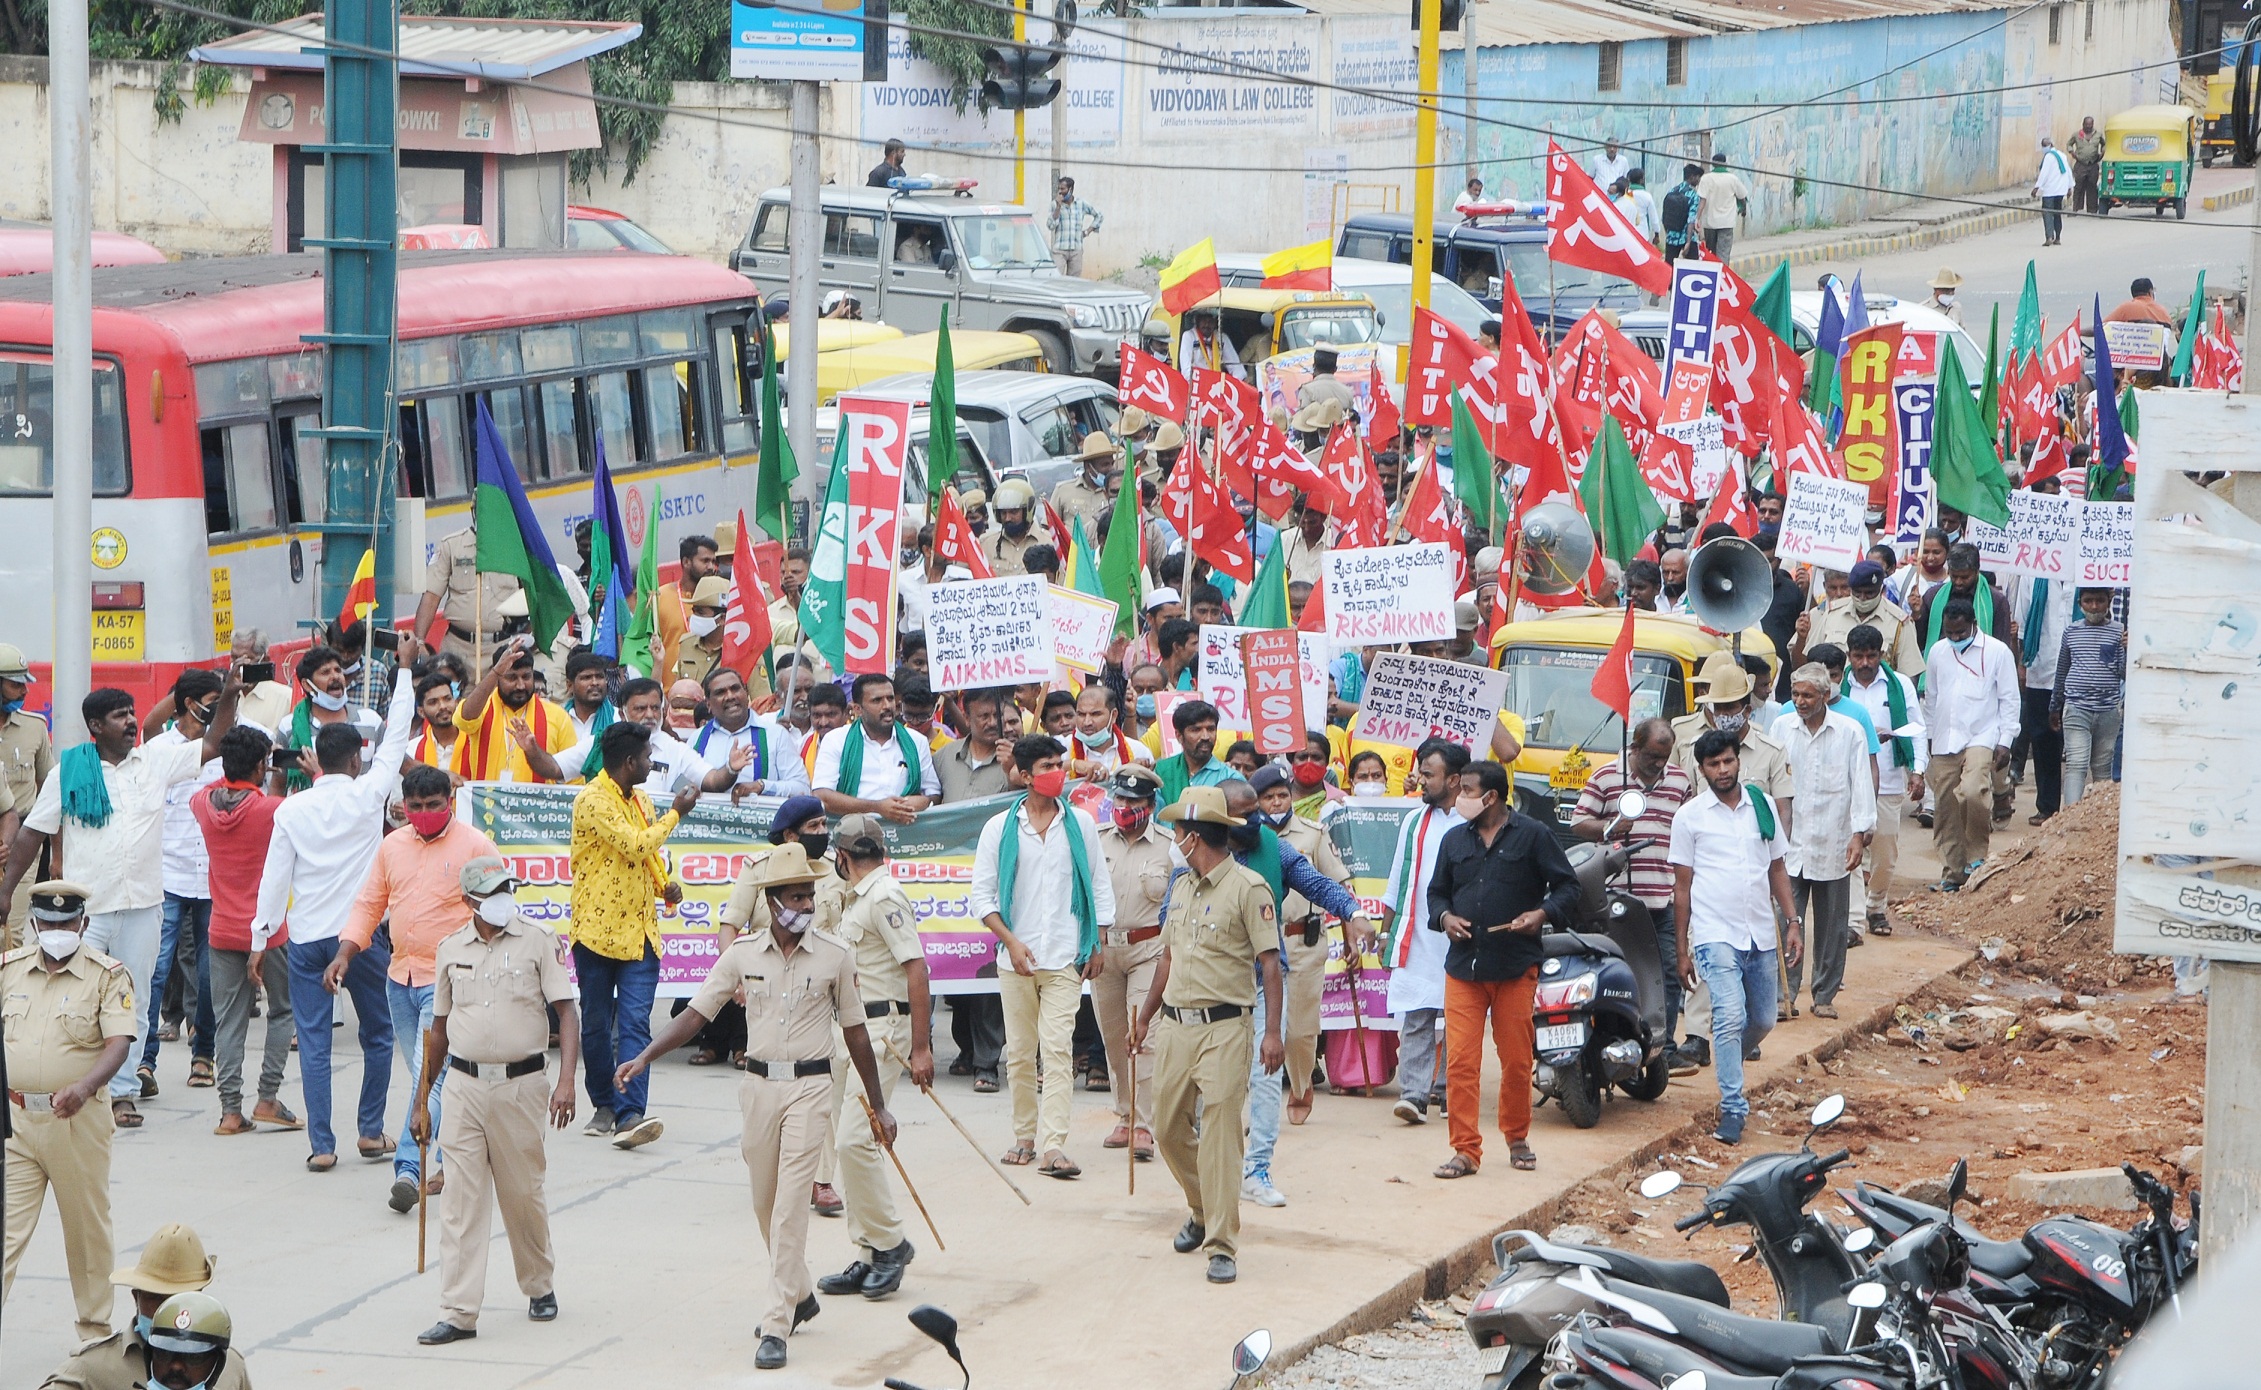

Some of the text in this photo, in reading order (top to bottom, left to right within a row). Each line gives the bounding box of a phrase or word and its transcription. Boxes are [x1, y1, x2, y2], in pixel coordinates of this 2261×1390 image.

[772, 20, 790, 29] Available
[811, 22, 825, 31] Layers
[1150, 86, 1314, 112] VIDYODAYA LAW COLLEGE
[1335, 95, 1377, 117] VIDYODAYA
[399, 111, 440, 131] OWKI
[1118, 349, 1138, 402] CITU
[1420, 320, 1449, 417] CITU
[1844, 340, 1893, 483] RKS
[1252, 413, 1272, 471] CITU
[1899, 387, 1932, 495] CITU
[1178, 440, 1192, 490] ITU
[845, 411, 901, 661] RKS
[1782, 531, 1813, 554] RKS
[1333, 557, 1353, 579] ರೈತ
[2014, 542, 2063, 573] RKS
[2083, 562, 2131, 582] SUCI
[1331, 582, 1339, 594] 3
[215, 611, 231, 626] KA-57
[1010, 601, 1017, 616] 2
[96, 615, 135, 629] KA-57
[92, 636, 135, 650] F-0865
[941, 653, 1026, 688] AIKKMS
[1250, 651, 1296, 669] INDIA
[1255, 668, 1294, 751] MSS
[500, 811, 536, 823] ಅಡುಗೆ
[500, 828, 539, 841] ಭೂಮಿ
[2178, 885, 2248, 917] ಪವರ್
[1547, 1024, 1578, 1039] KA06H
[1548, 1035, 1579, 1048] K3594
[2091, 1253, 2126, 1279] 06
